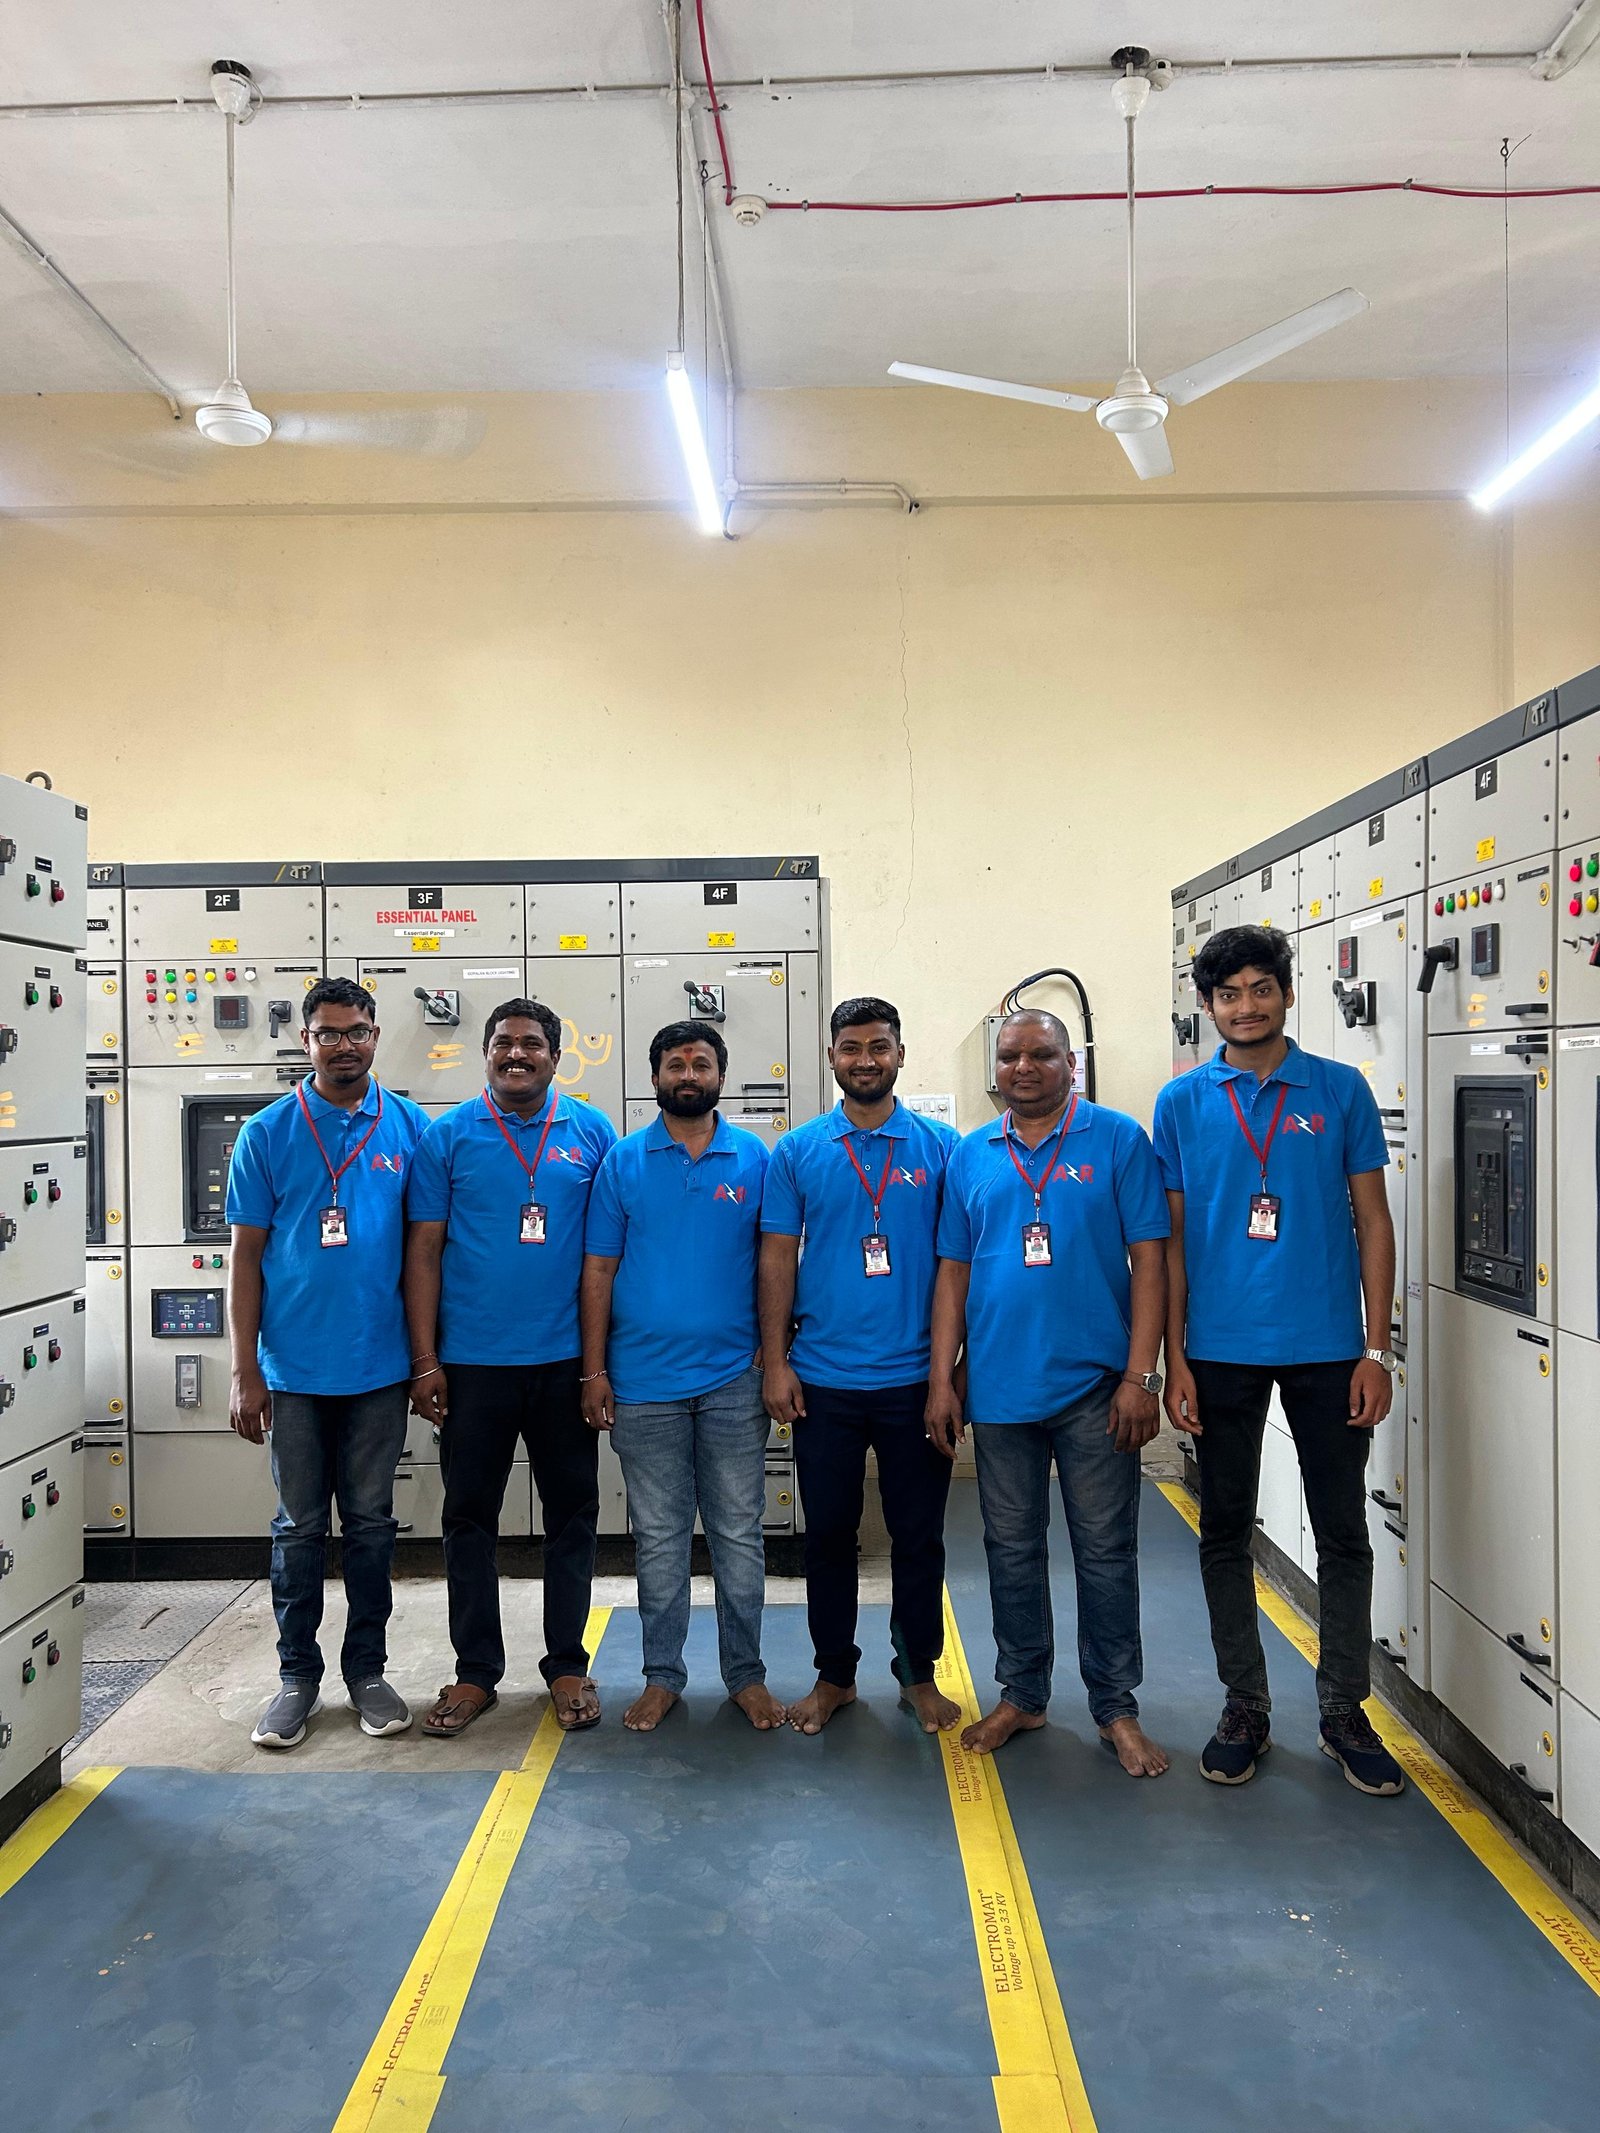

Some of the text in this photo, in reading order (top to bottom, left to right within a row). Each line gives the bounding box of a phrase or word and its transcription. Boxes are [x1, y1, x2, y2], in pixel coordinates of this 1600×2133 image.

[1480, 770, 1491, 789] 4F
[417, 892, 434, 904] 3F
[712, 887, 729, 899] 4F
[214, 895, 231, 906] 2F
[376, 910, 478, 924] ESSENTIAL PANEL
[87, 921, 105, 929] ANEL
[968, 1765, 977, 1774] up
[970, 1774, 983, 1802] Voltage
[1555, 1914, 1576, 1928] KV
[995, 1891, 1024, 1991] Voltage up to 3.3 KV
[1571, 1930, 1592, 1945] 3.3
[1542, 1915, 1600, 1983] TROMAT
